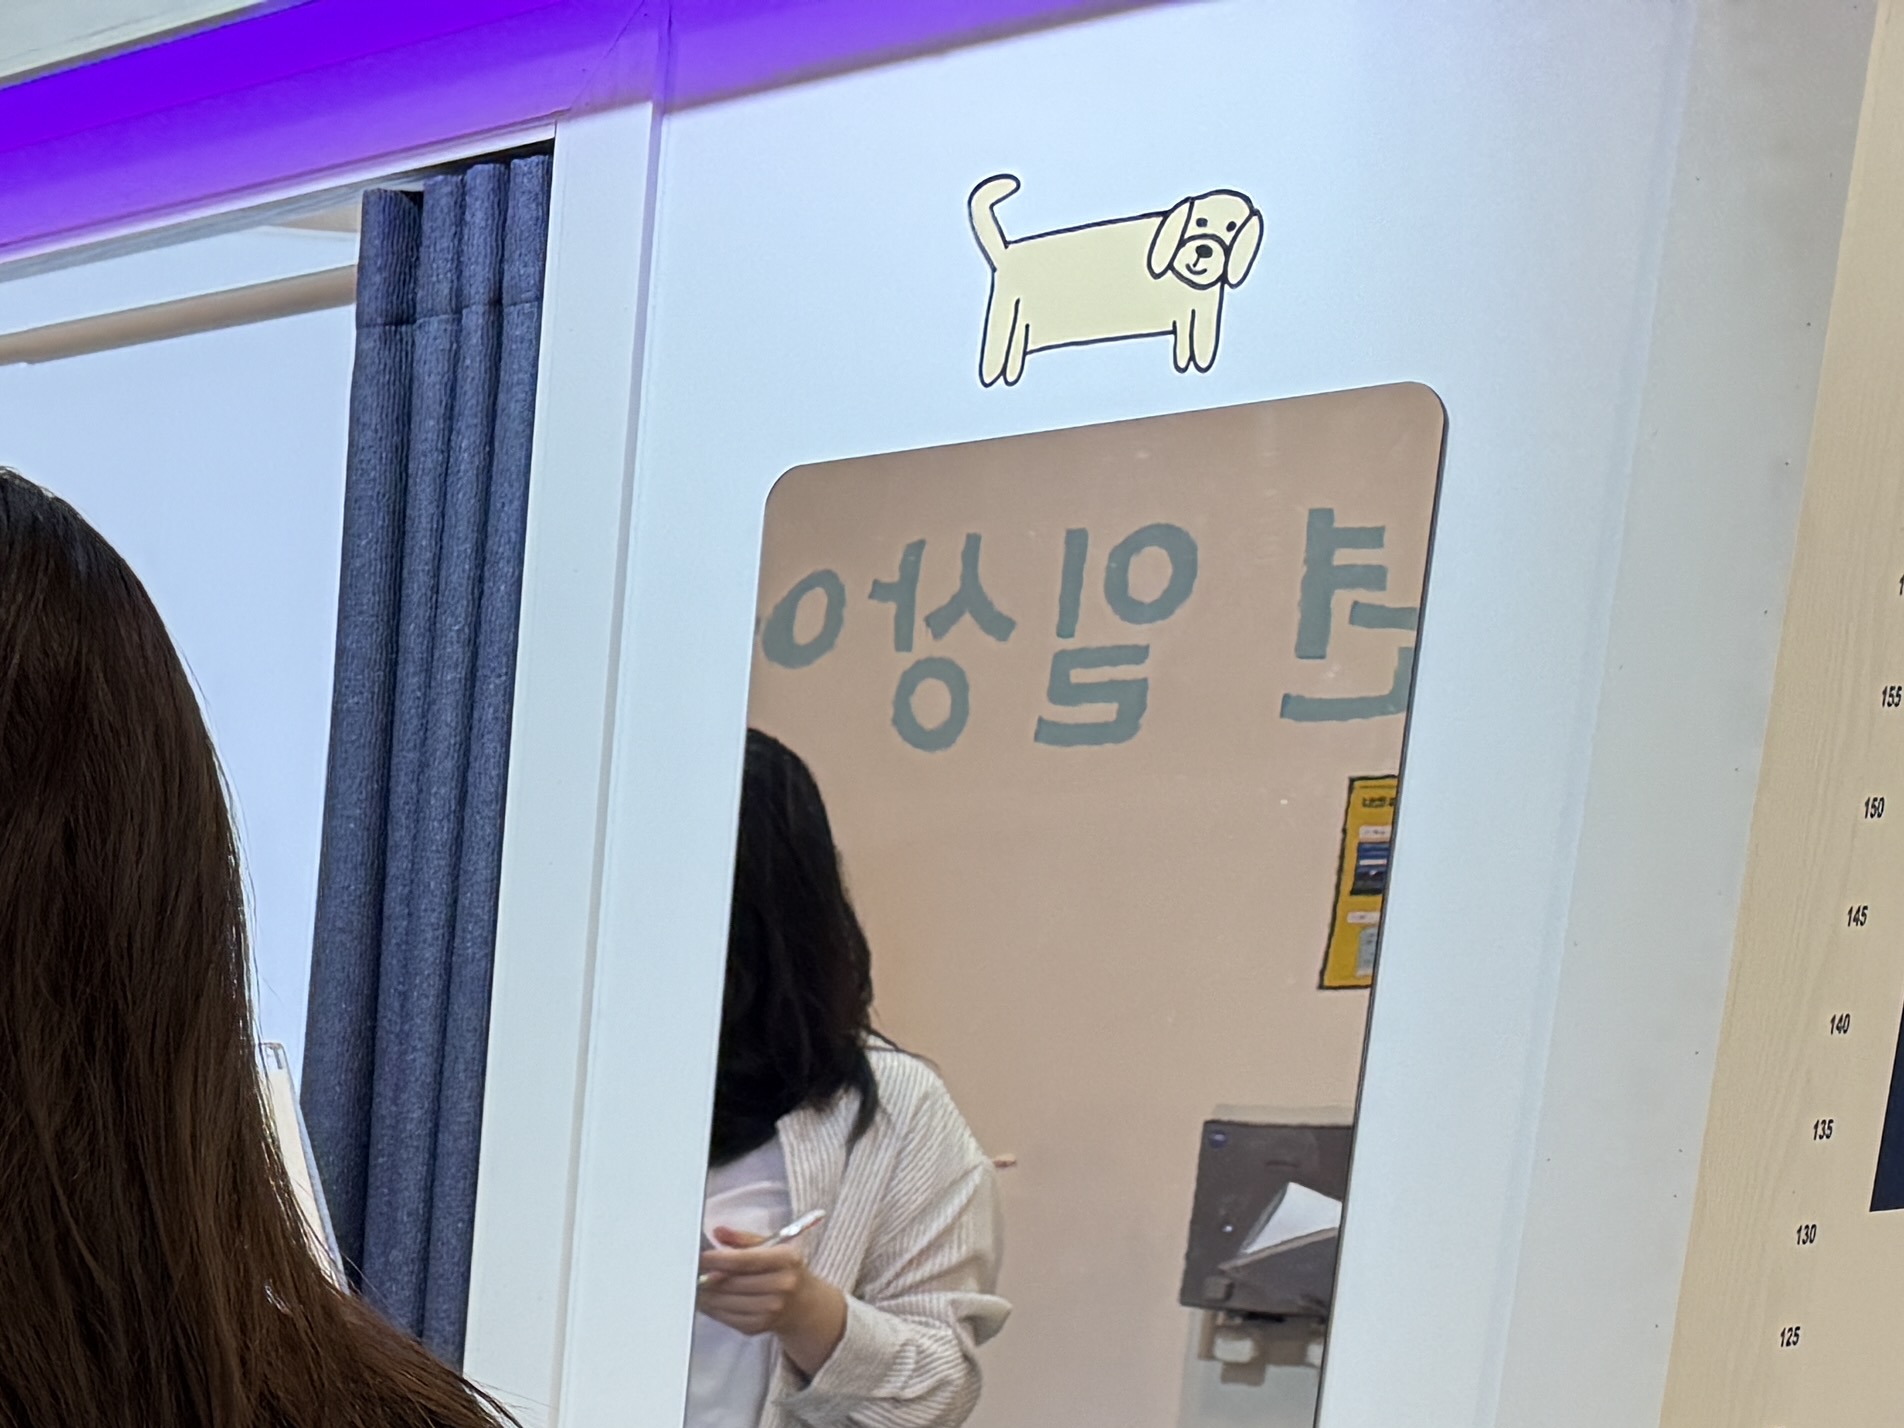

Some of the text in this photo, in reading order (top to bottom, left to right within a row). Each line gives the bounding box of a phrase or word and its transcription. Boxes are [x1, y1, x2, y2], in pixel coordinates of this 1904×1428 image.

[1881, 685, 1903, 708] 155
[1864, 796, 1885, 819] 150
[1847, 905, 1869, 928] 145
[1830, 1013, 1851, 1036] 140
[1813, 1118, 1835, 1141] 135
[1796, 1223, 1818, 1246] 130
[1780, 1325, 1801, 1348] 125
